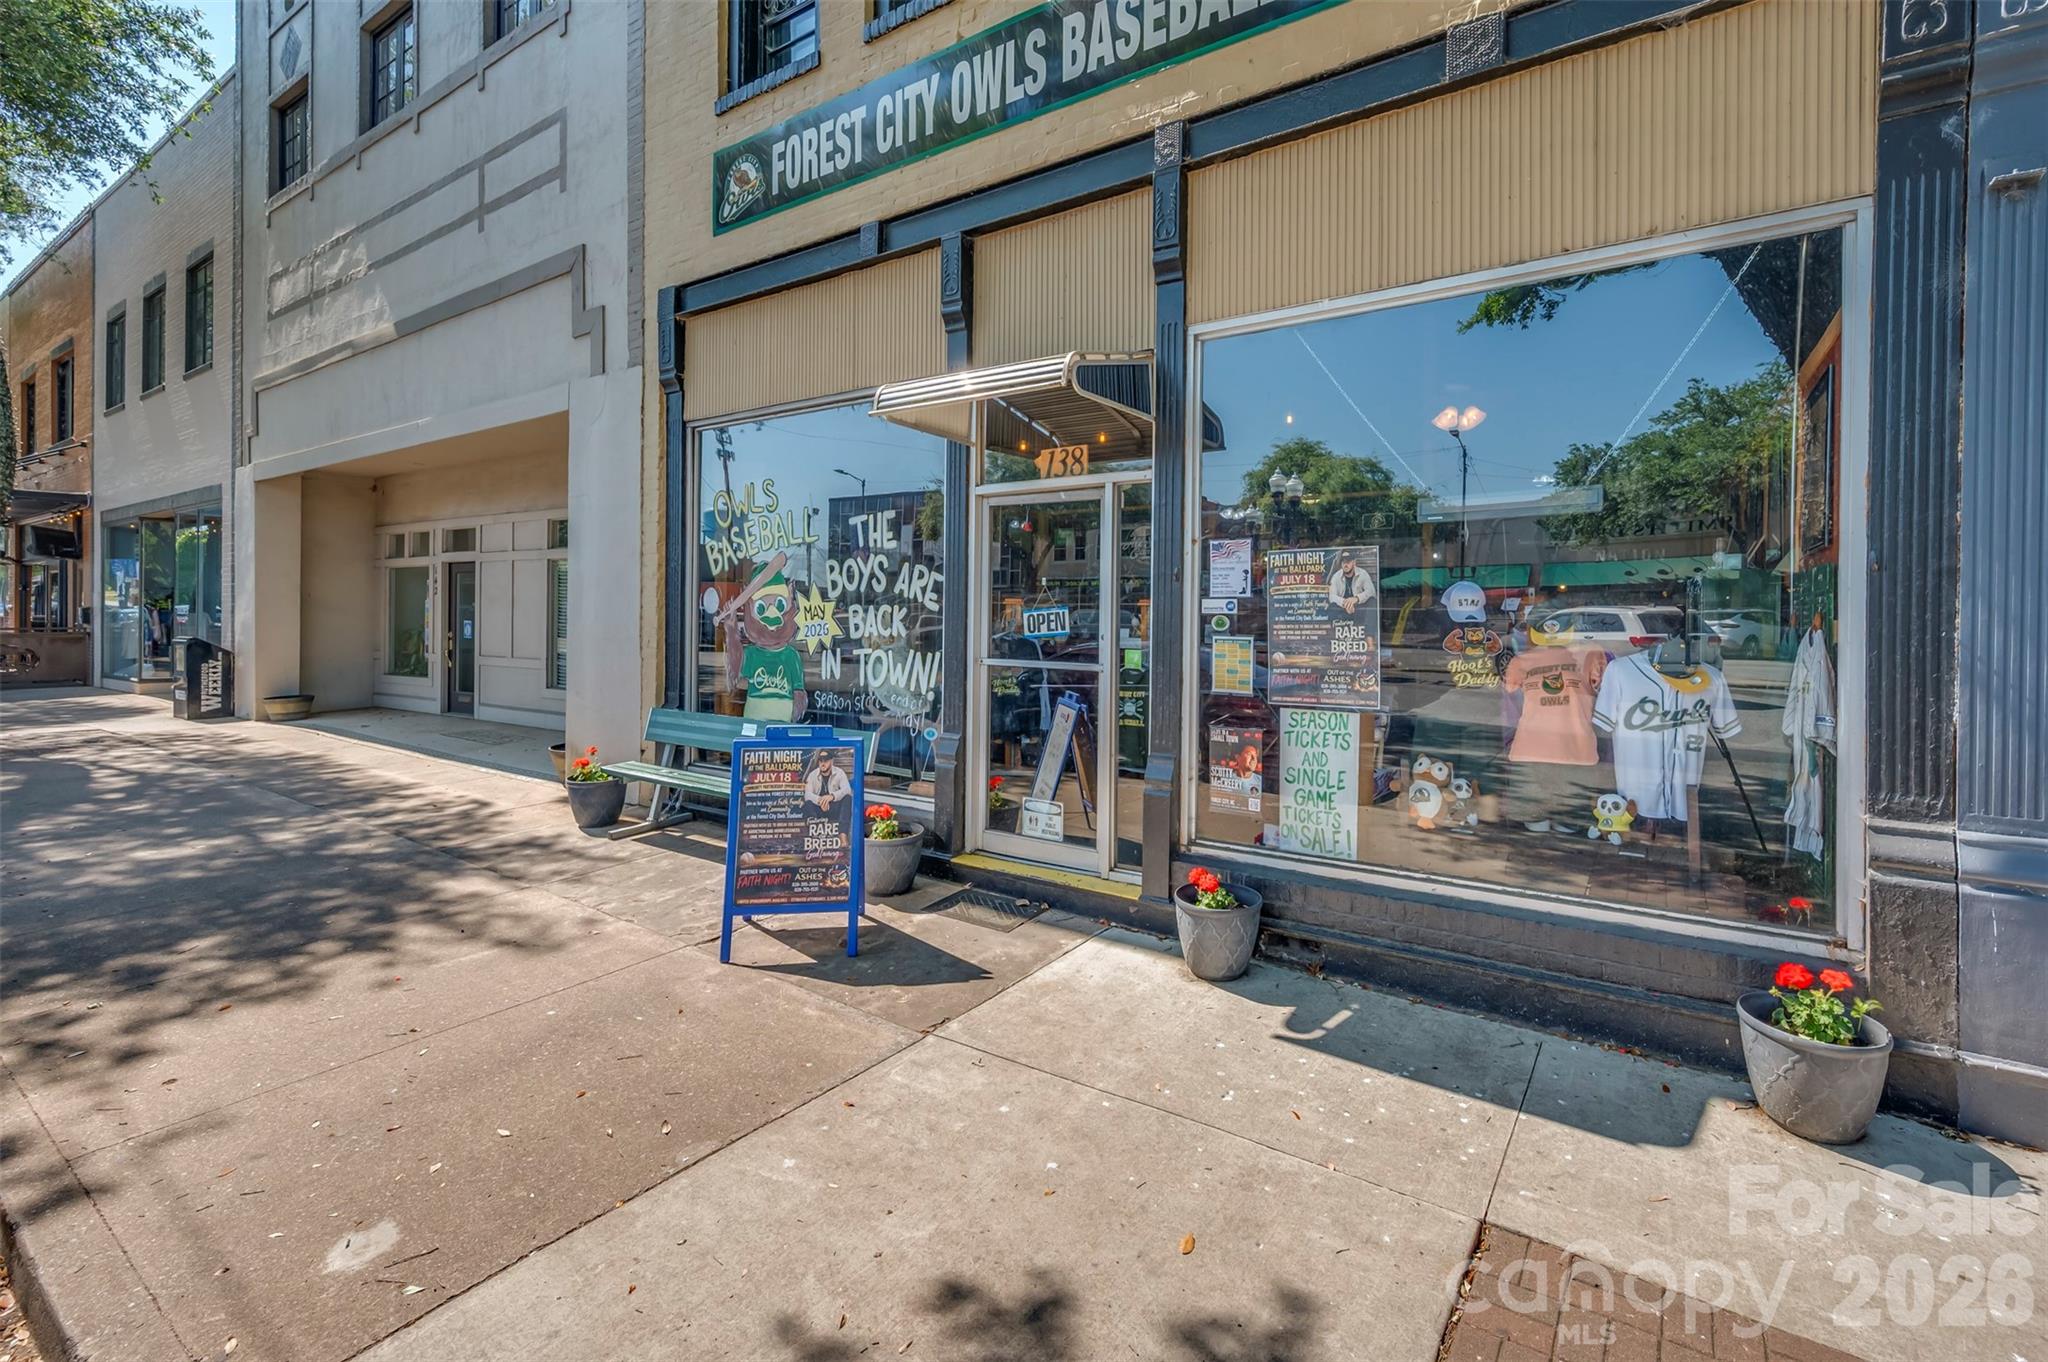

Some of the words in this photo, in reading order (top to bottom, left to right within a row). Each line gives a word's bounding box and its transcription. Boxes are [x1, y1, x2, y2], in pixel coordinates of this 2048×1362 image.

[769, 105, 866, 196] FOREST
[875, 73, 944, 155] CITY
[950, 27, 1048, 125] OWLS
[1062, 0, 1278, 83] BASEB
[1046, 446, 1085, 478] 138
[713, 478, 778, 528] OWLS
[848, 509, 898, 551] THE
[705, 506, 819, 577] BASEBALL
[1270, 553, 1294, 568] FAITH
[1296, 552, 1325, 565] NIGHT
[1289, 564, 1326, 574] BALLPARK
[825, 553, 889, 599] BOYS
[893, 561, 944, 612] ARE
[1280, 574, 1301, 585] JULY
[1303, 574, 1316, 584] 18
[804, 604, 826, 620] MAY
[804, 622, 829, 639] 2026
[848, 603, 907, 641] BACK
[1026, 610, 1066, 634] OPEN
[1335, 626, 1365, 639] RARE
[1330, 640, 1368, 653] BREED
[1447, 657, 1492, 673] Hoot's
[753, 665, 789, 694] Owls
[820, 647, 841, 681] IN
[852, 648, 941, 702] TOWN!
[1323, 675, 1351, 683] ASHES
[1453, 672, 1500, 688] Daddy
[201, 660, 222, 713] WEEKLY
[1540, 695, 1570, 706] OWLS
[1288, 711, 1350, 731] SEASON
[1623, 696, 1711, 733] Owls
[1284, 730, 1352, 750] TICKETS
[744, 751, 769, 766] FAITH
[773, 750, 803, 763] NIGHT
[1301, 751, 1328, 768] AND
[764, 763, 803, 772] BALLPARK
[1210, 766, 1233, 778] SCOTTY
[754, 773, 777, 783] JULY
[779, 772, 792, 782] 18
[1284, 767, 1346, 790] SINGLE
[1294, 788, 1337, 810] GAME
[1282, 805, 1341, 830] TICKETS
[808, 823, 839, 836] RARE
[804, 837, 841, 850] BREED
[1280, 823, 1298, 840] ON
[1300, 825, 1352, 858] SALE!
[737, 875, 761, 889] FAITH
[794, 873, 823, 881] ASHES
